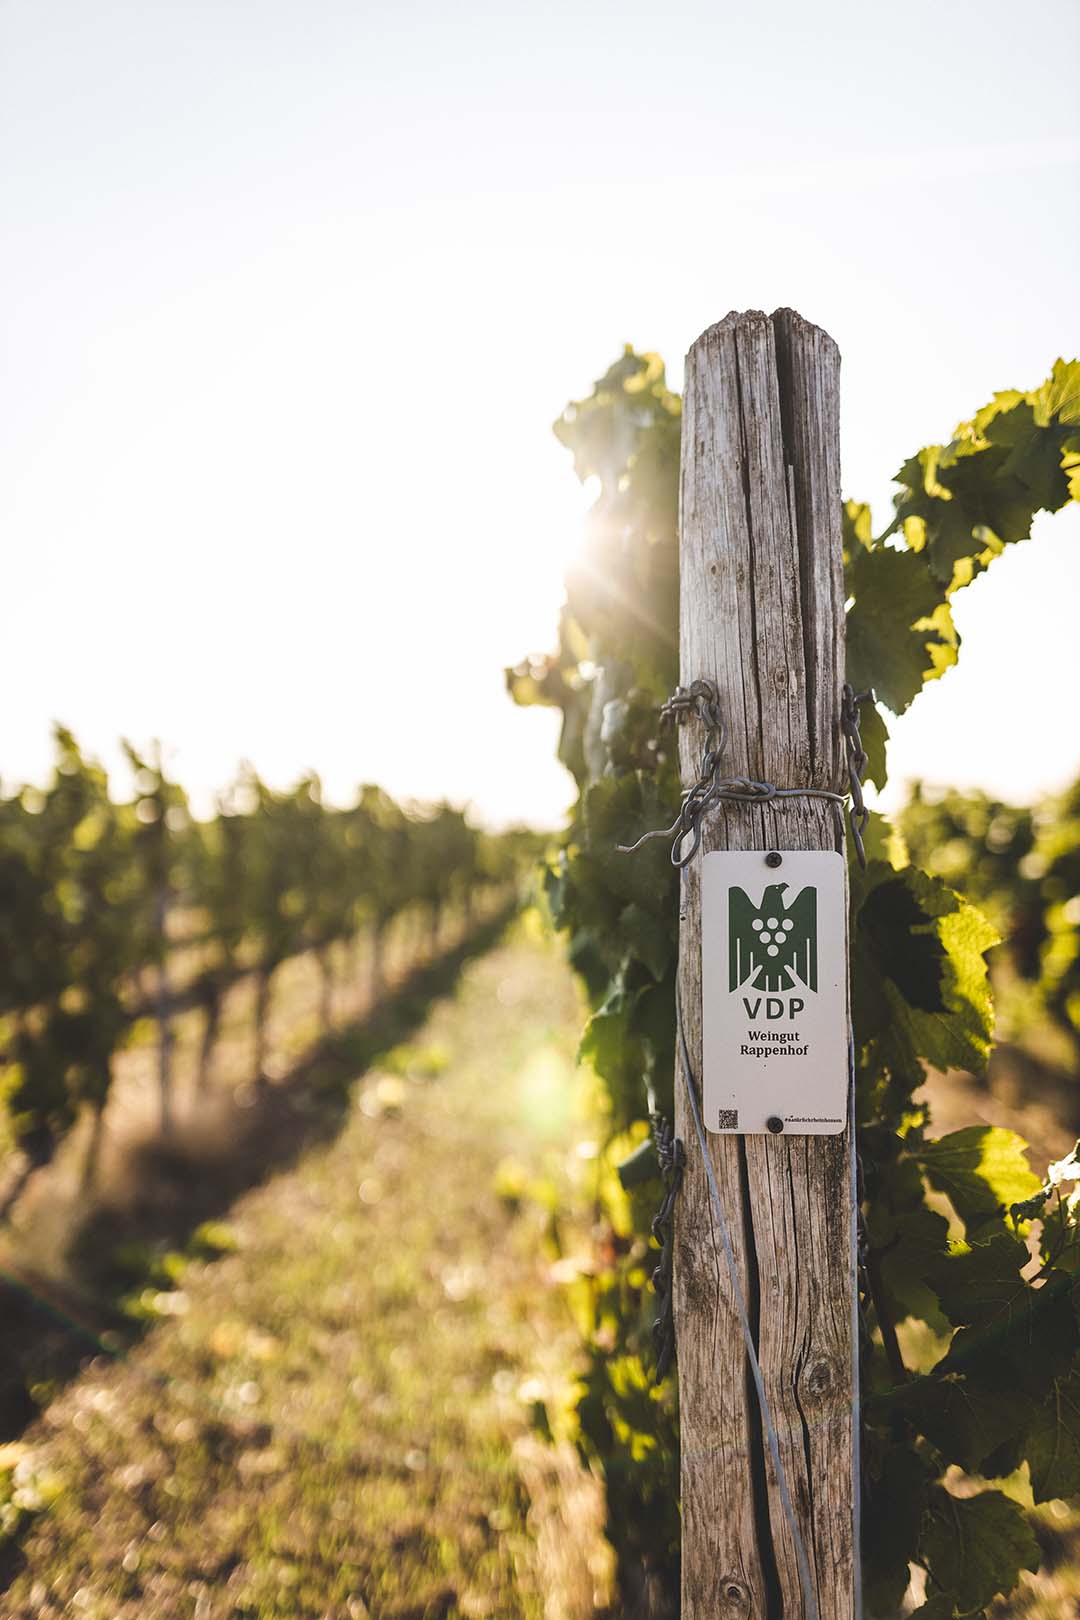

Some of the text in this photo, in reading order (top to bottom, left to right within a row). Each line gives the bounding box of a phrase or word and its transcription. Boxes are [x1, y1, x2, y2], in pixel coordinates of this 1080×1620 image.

[743, 998, 804, 1019] VDP
[748, 1031, 800, 1044] Weingut
[740, 1045, 809, 1058] Rappenhof
